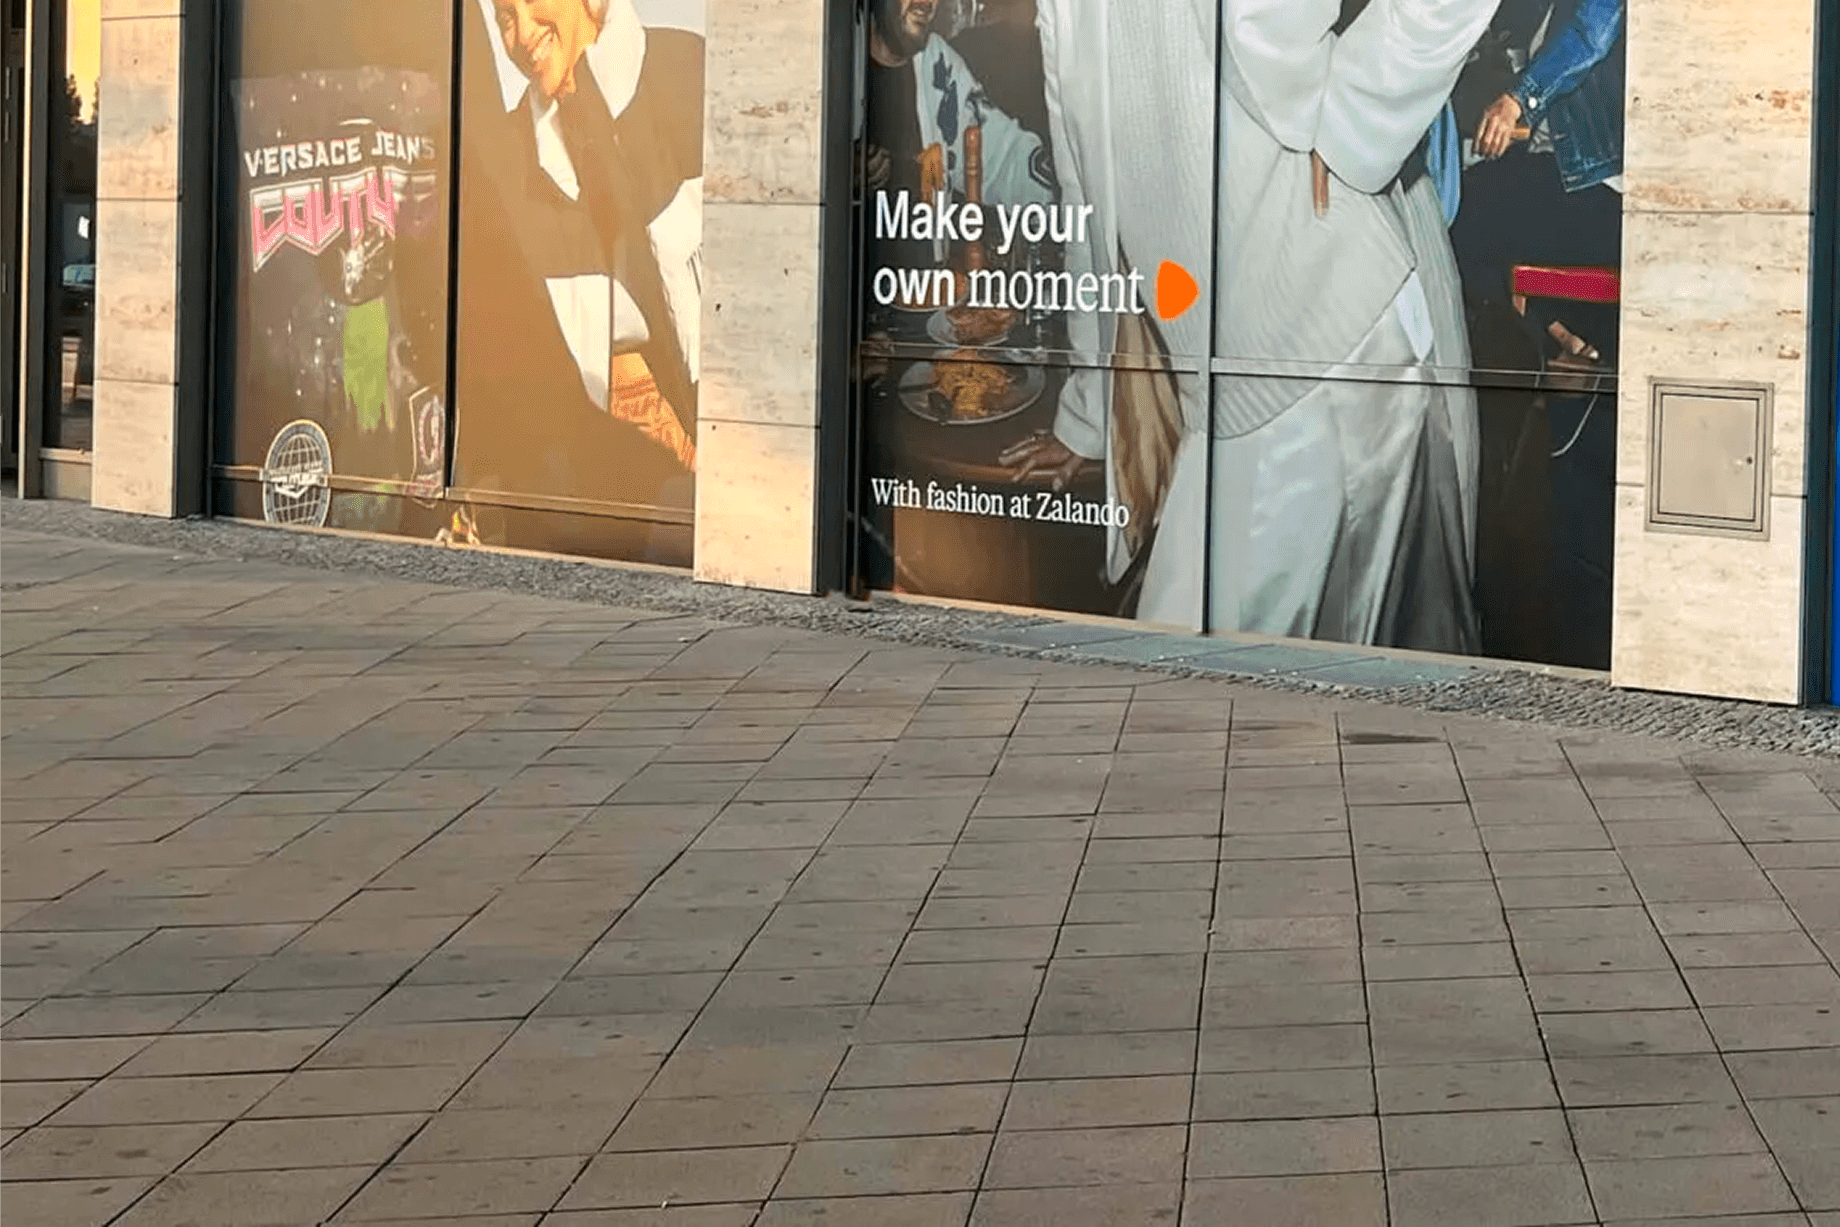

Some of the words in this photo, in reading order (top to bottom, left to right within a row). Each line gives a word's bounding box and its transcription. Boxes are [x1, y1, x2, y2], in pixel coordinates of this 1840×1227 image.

[244, 136, 362, 177] VERSACE
[371, 131, 435, 165] JEANS
[875, 190, 984, 241] Make
[996, 203, 1094, 255] your
[873, 267, 955, 305] own
[966, 267, 1146, 314] moment
[871, 478, 921, 508] With
[926, 481, 1004, 516] fashion
[1009, 495, 1031, 518] at
[1036, 493, 1130, 528] Zalando
